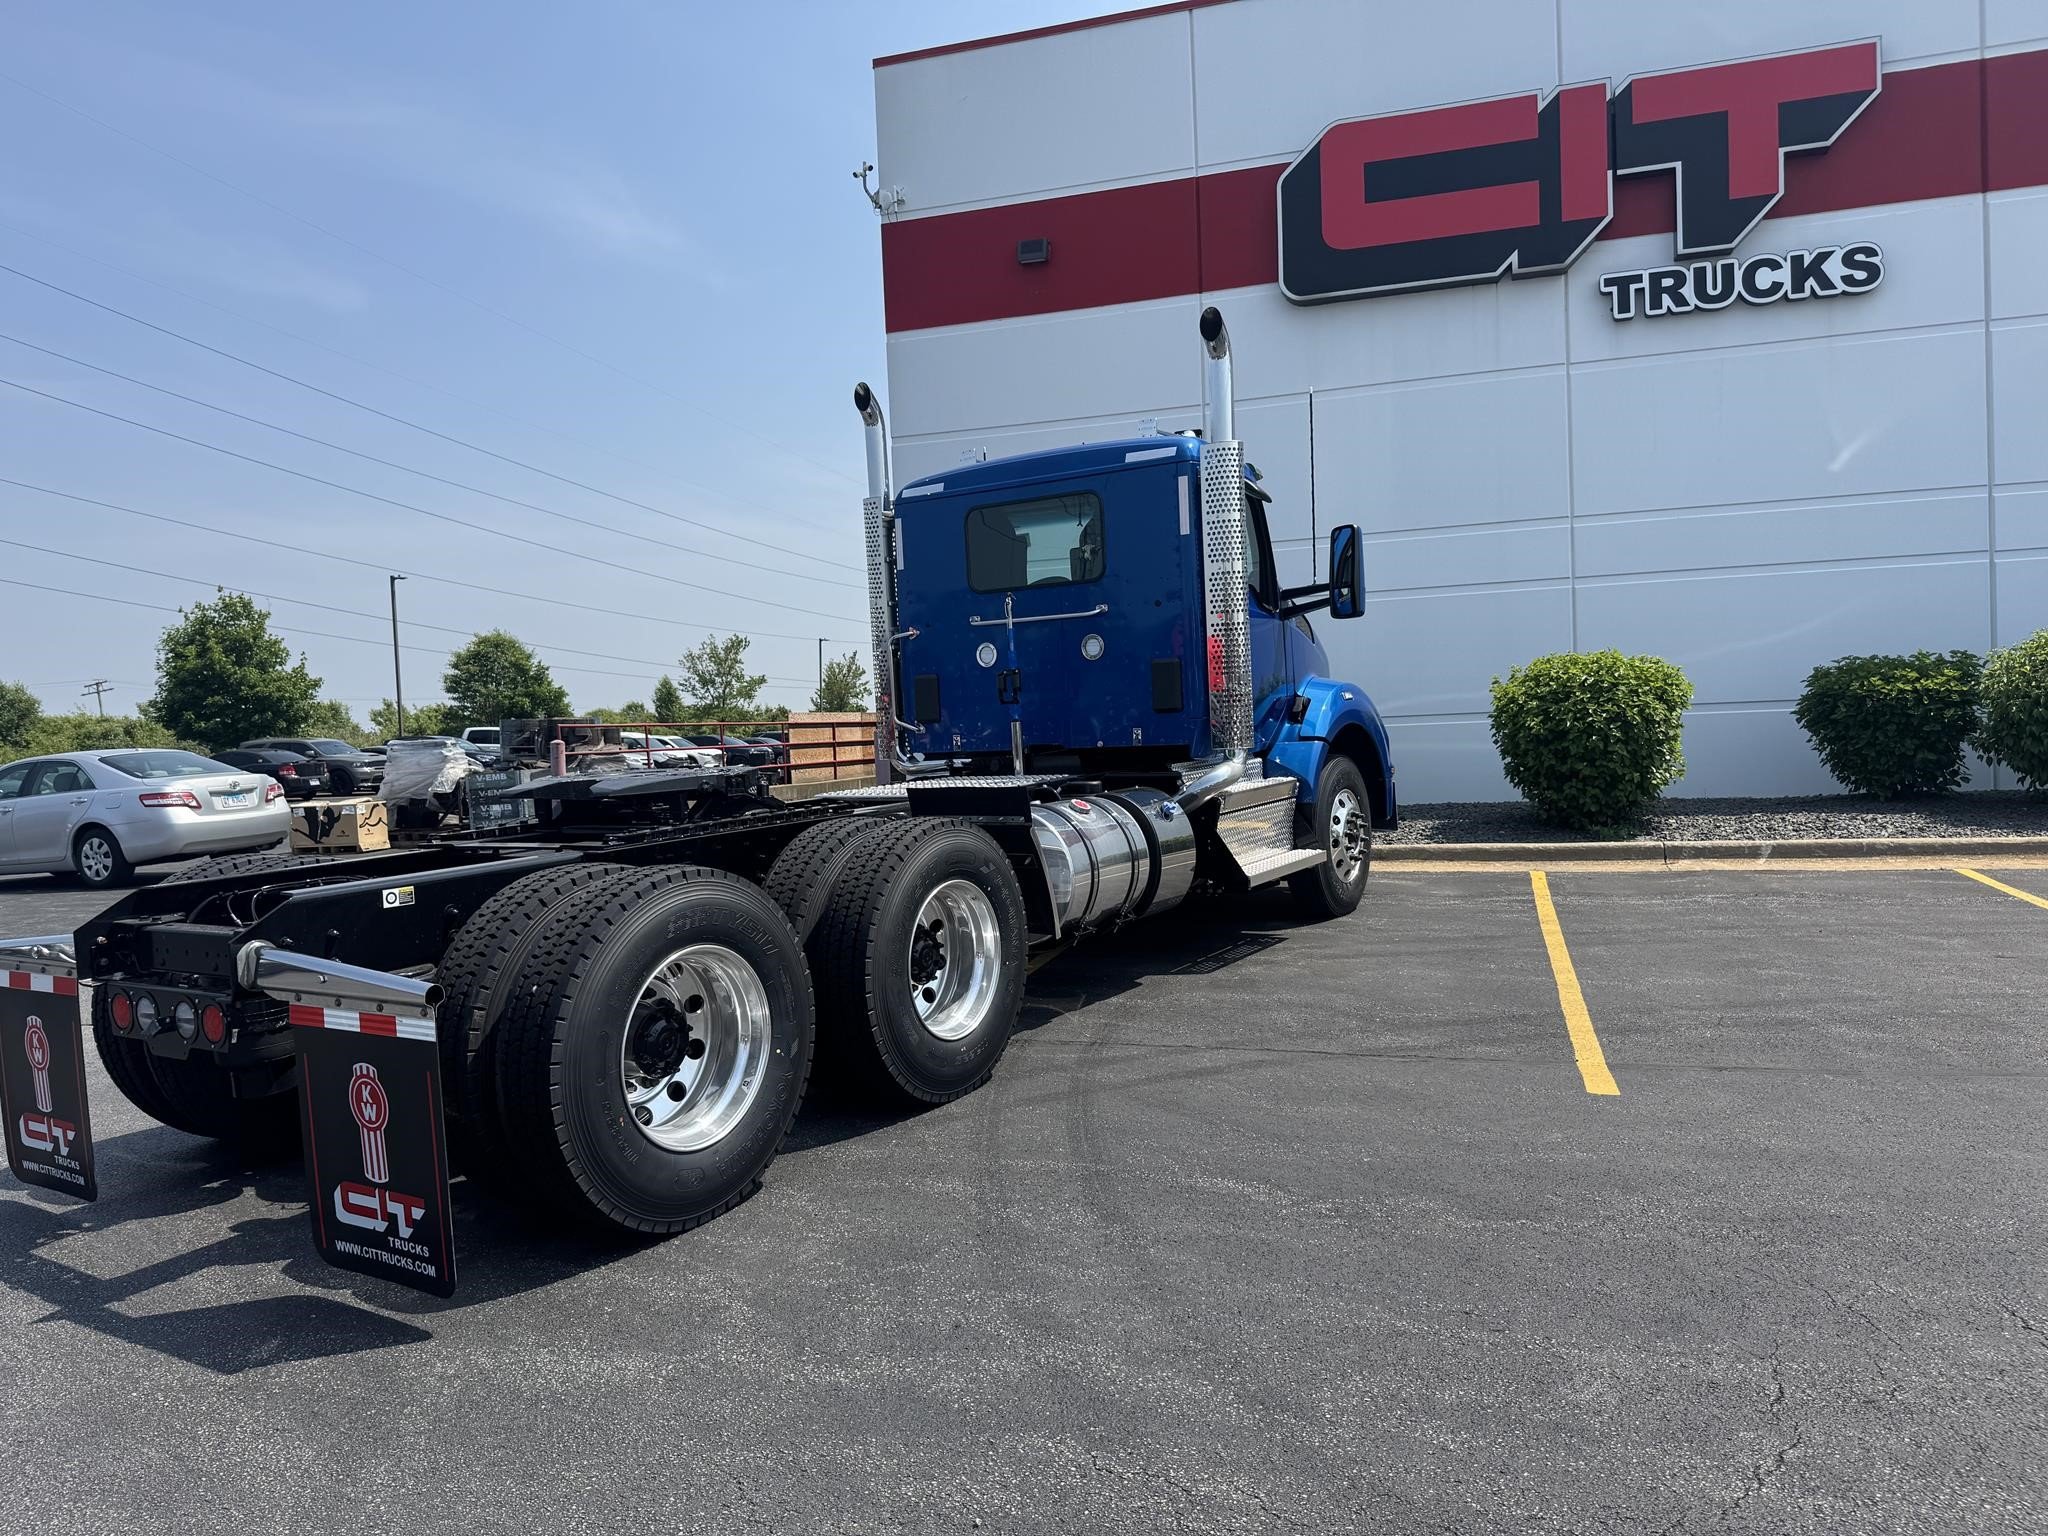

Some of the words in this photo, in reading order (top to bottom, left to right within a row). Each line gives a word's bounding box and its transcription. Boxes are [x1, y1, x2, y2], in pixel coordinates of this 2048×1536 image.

[1278, 37, 1881, 303] CIT
[1600, 242, 1885, 320] TRUCKS
[19, 1112, 76, 1156] CIT
[21, 1159, 85, 1186] WWW.CITTRUCKS.COM
[54, 1154, 80, 1170] TRUCKS
[334, 1181, 426, 1239] CIT
[335, 1239, 437, 1278] WWW.CITTRUCKS.COM
[387, 1236, 430, 1257] TRUCKS
